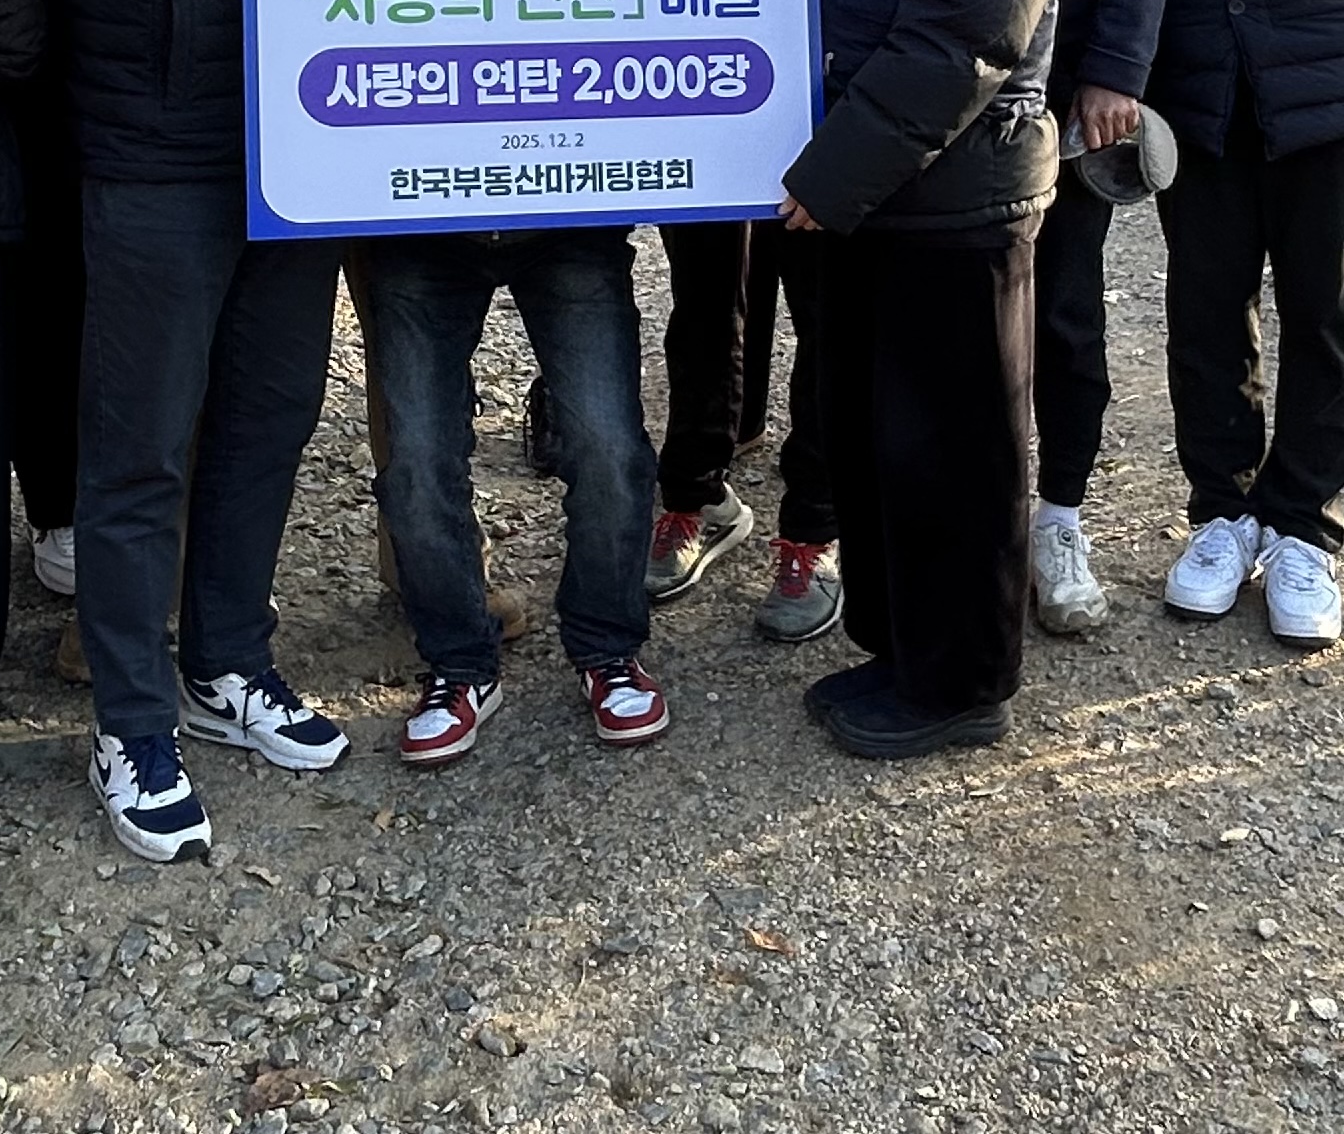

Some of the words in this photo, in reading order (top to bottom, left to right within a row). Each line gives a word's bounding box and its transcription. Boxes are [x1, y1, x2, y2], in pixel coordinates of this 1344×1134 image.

[325, 62, 460, 108] 사랑의
[472, 58, 562, 106] 연탄
[572, 53, 751, 105] 2,000장
[390, 158, 694, 201] 한국부동산마케팅협회
